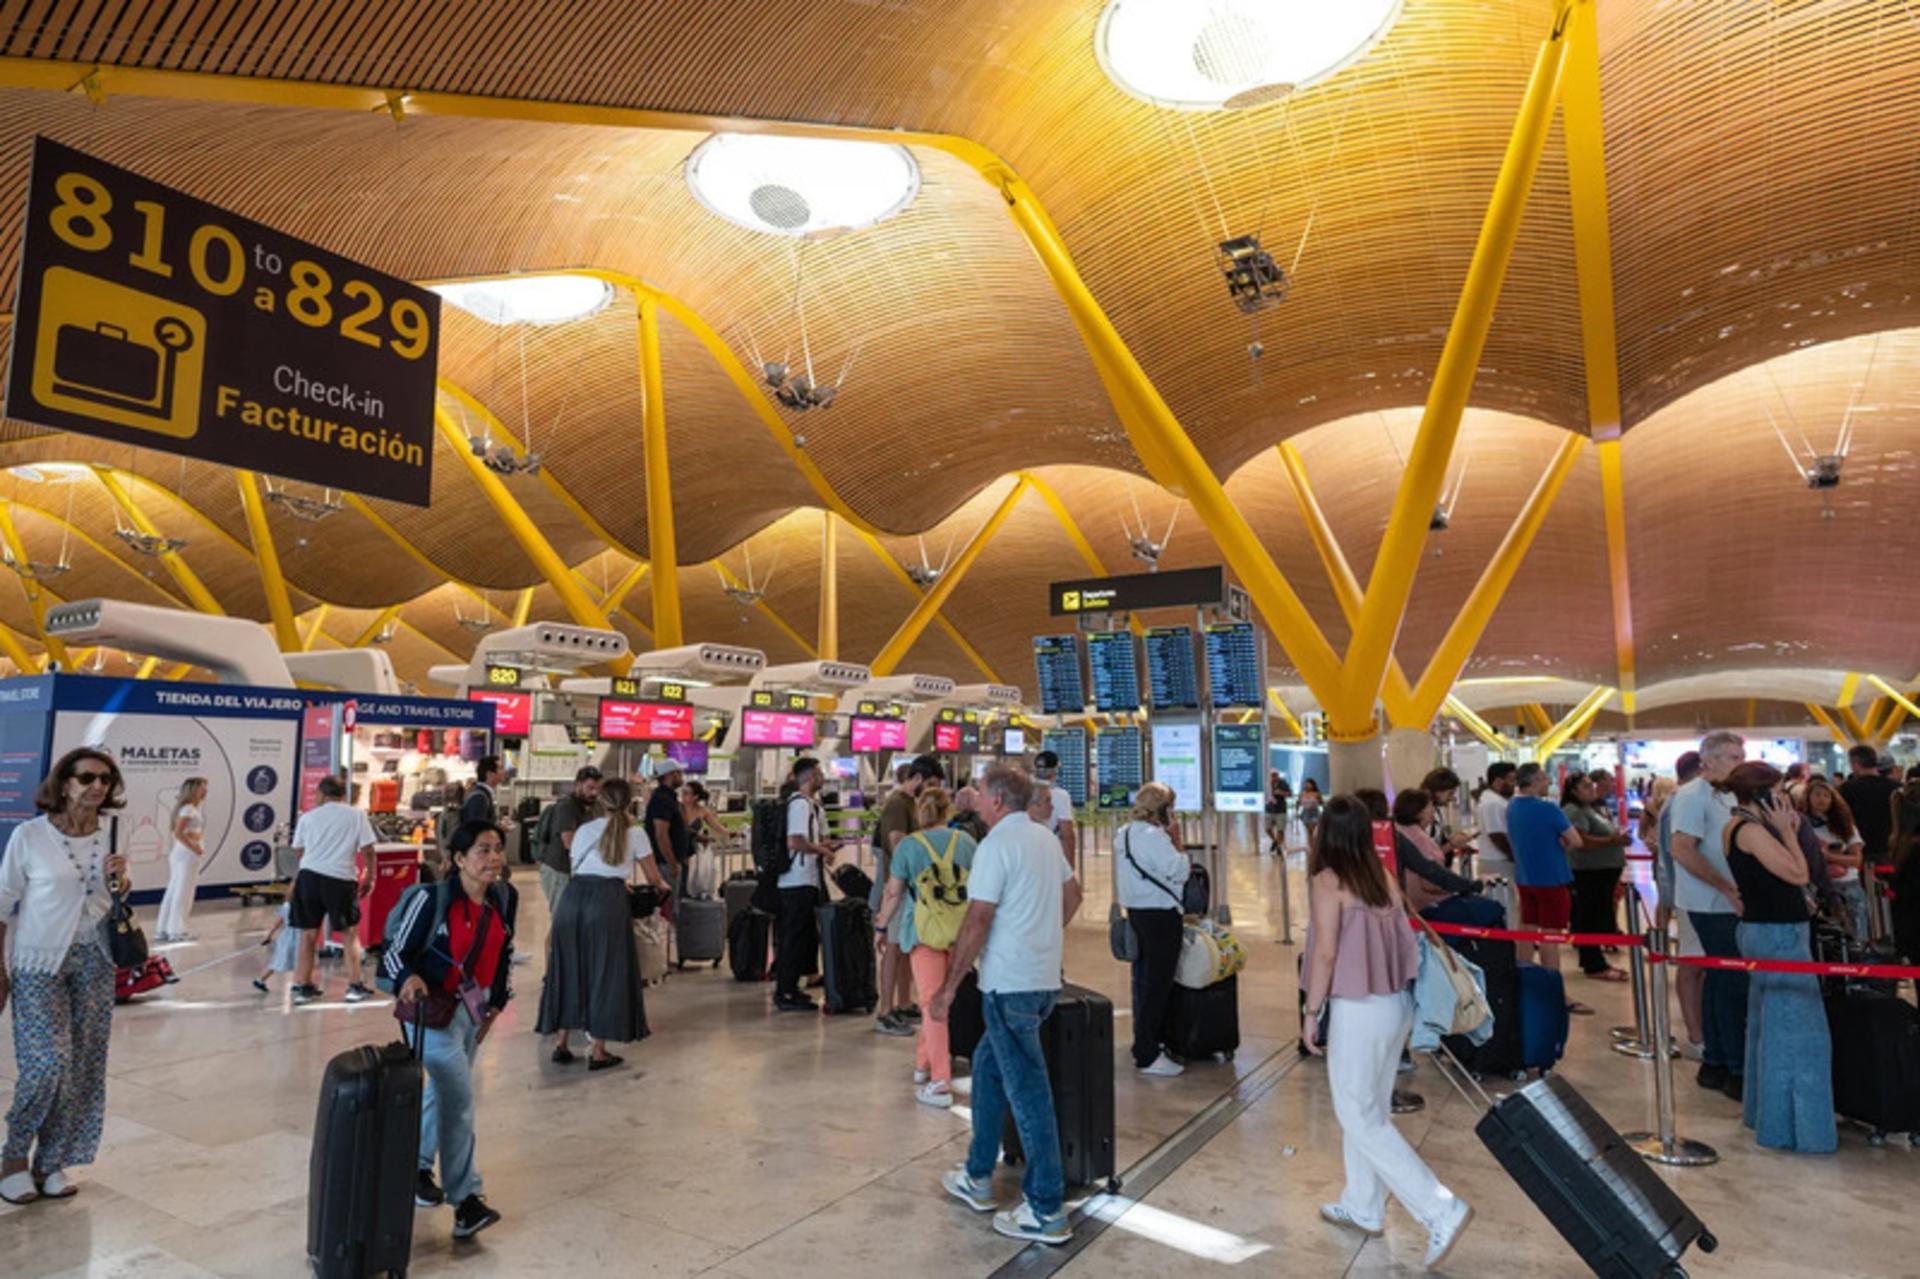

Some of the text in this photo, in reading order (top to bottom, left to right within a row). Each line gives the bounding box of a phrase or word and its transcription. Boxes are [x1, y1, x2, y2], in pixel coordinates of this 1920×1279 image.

[49, 172, 430, 360] 810 to 829
[254, 286, 275, 312] a
[274, 365, 385, 419] Check-in
[216, 386, 424, 466] Facturación
[490, 667, 517, 685] 820
[615, 680, 637, 695] 821
[155, 691, 303, 710] TIENDA DEL VIAJERO
[377, 704, 402, 715] AND
[404, 705, 441, 718] TRAVEL
[443, 707, 474, 719] STORE
[121, 746, 201, 759] MALETAS
